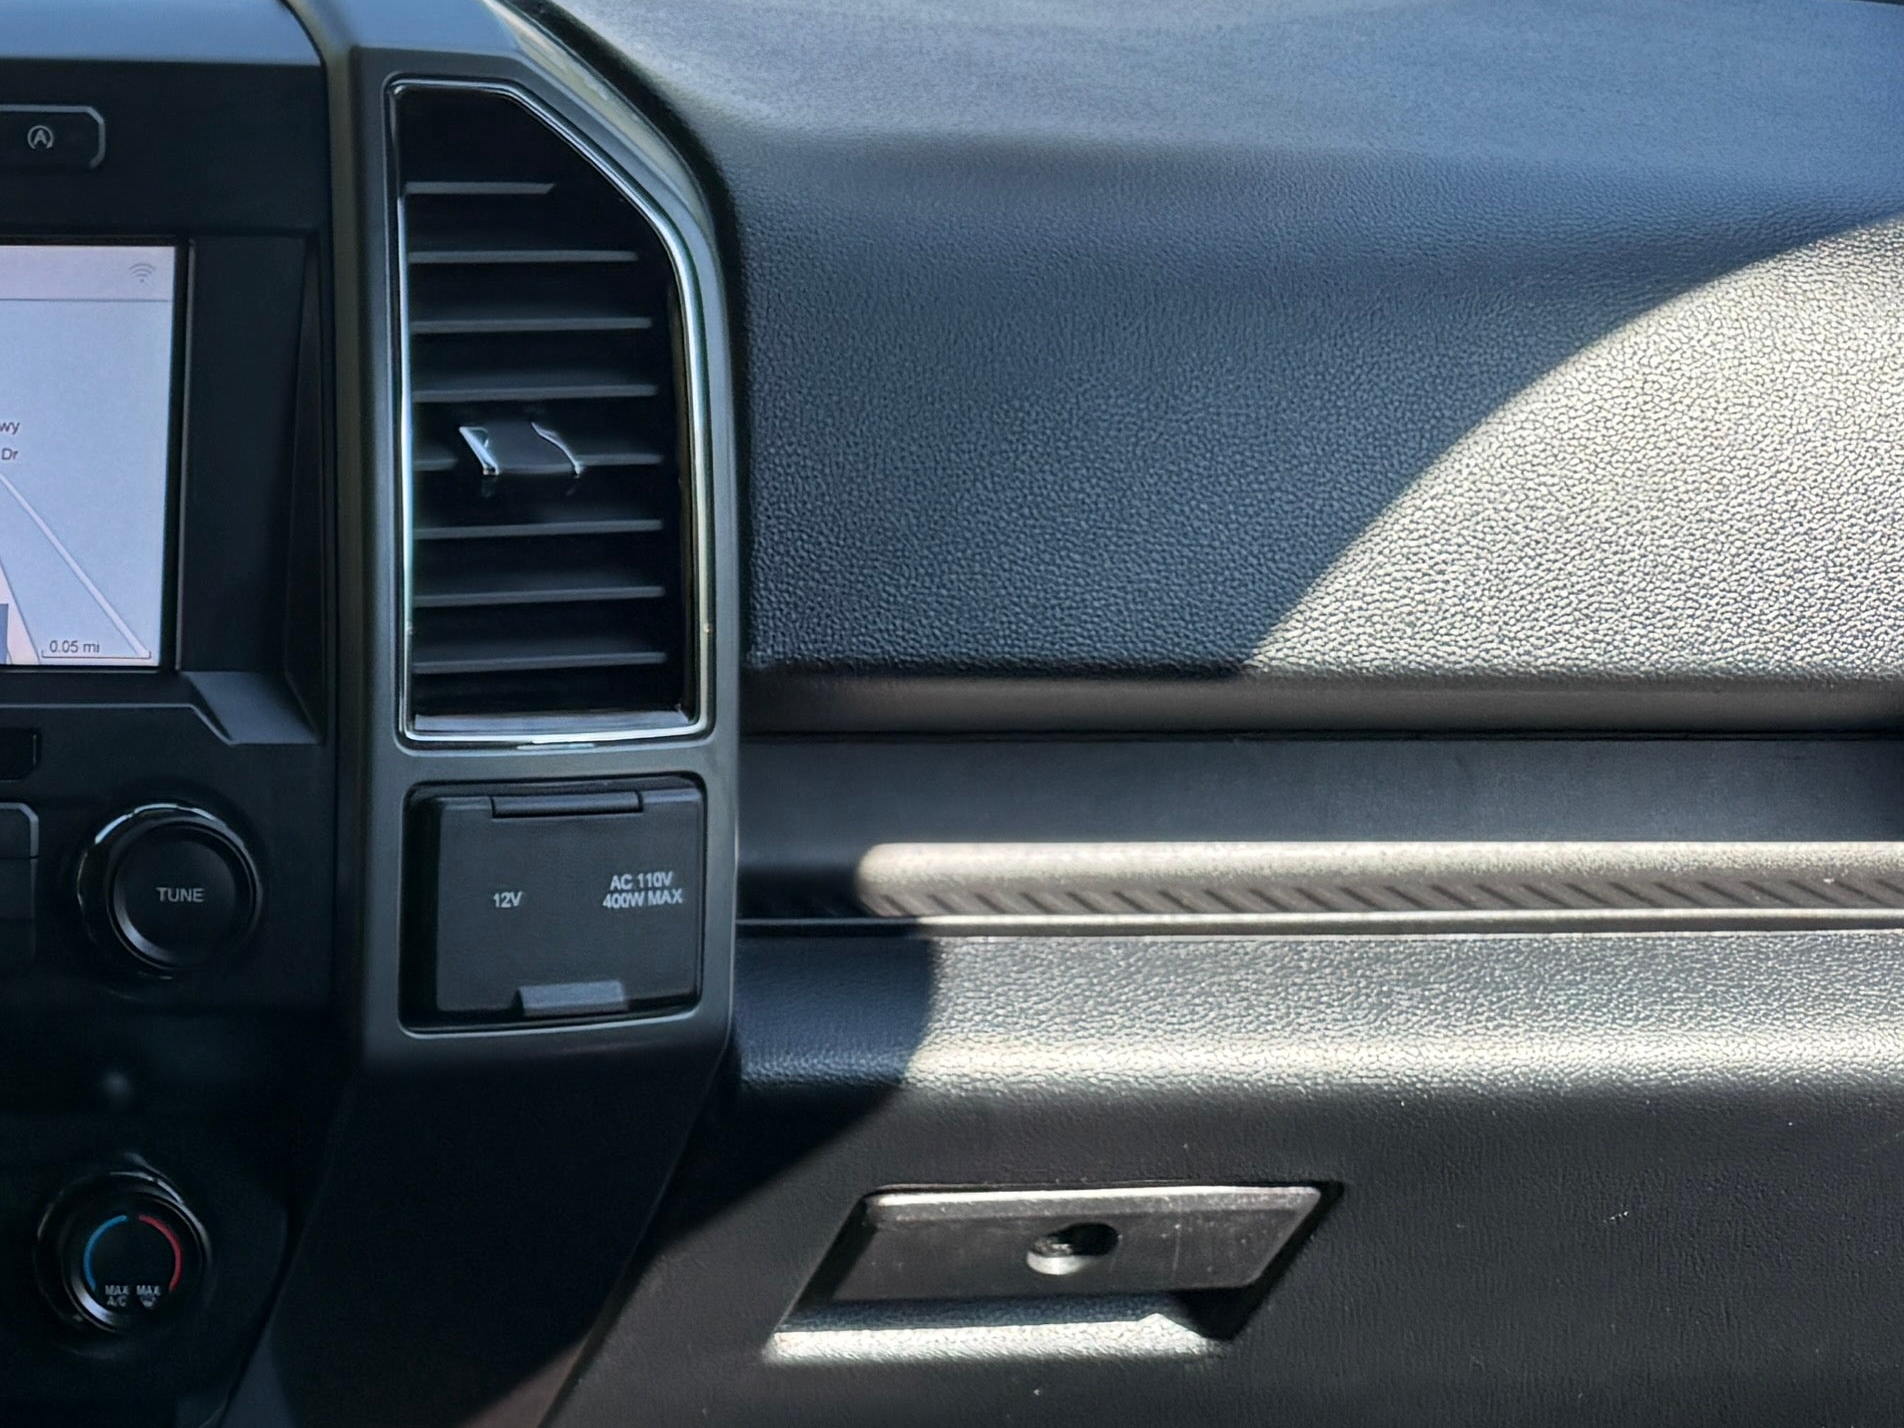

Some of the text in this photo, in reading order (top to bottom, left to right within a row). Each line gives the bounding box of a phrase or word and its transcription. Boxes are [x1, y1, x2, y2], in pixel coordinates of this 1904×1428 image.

[0, 447, 19, 461] Dr
[49, 639, 100, 654] 0.05 mi
[609, 871, 674, 891] AC 110V
[155, 886, 206, 903] TUNE
[492, 891, 523, 909] 12V
[602, 888, 684, 909] 400W MAX
[104, 1284, 129, 1295] MAX
[136, 1284, 161, 1296] MAX
